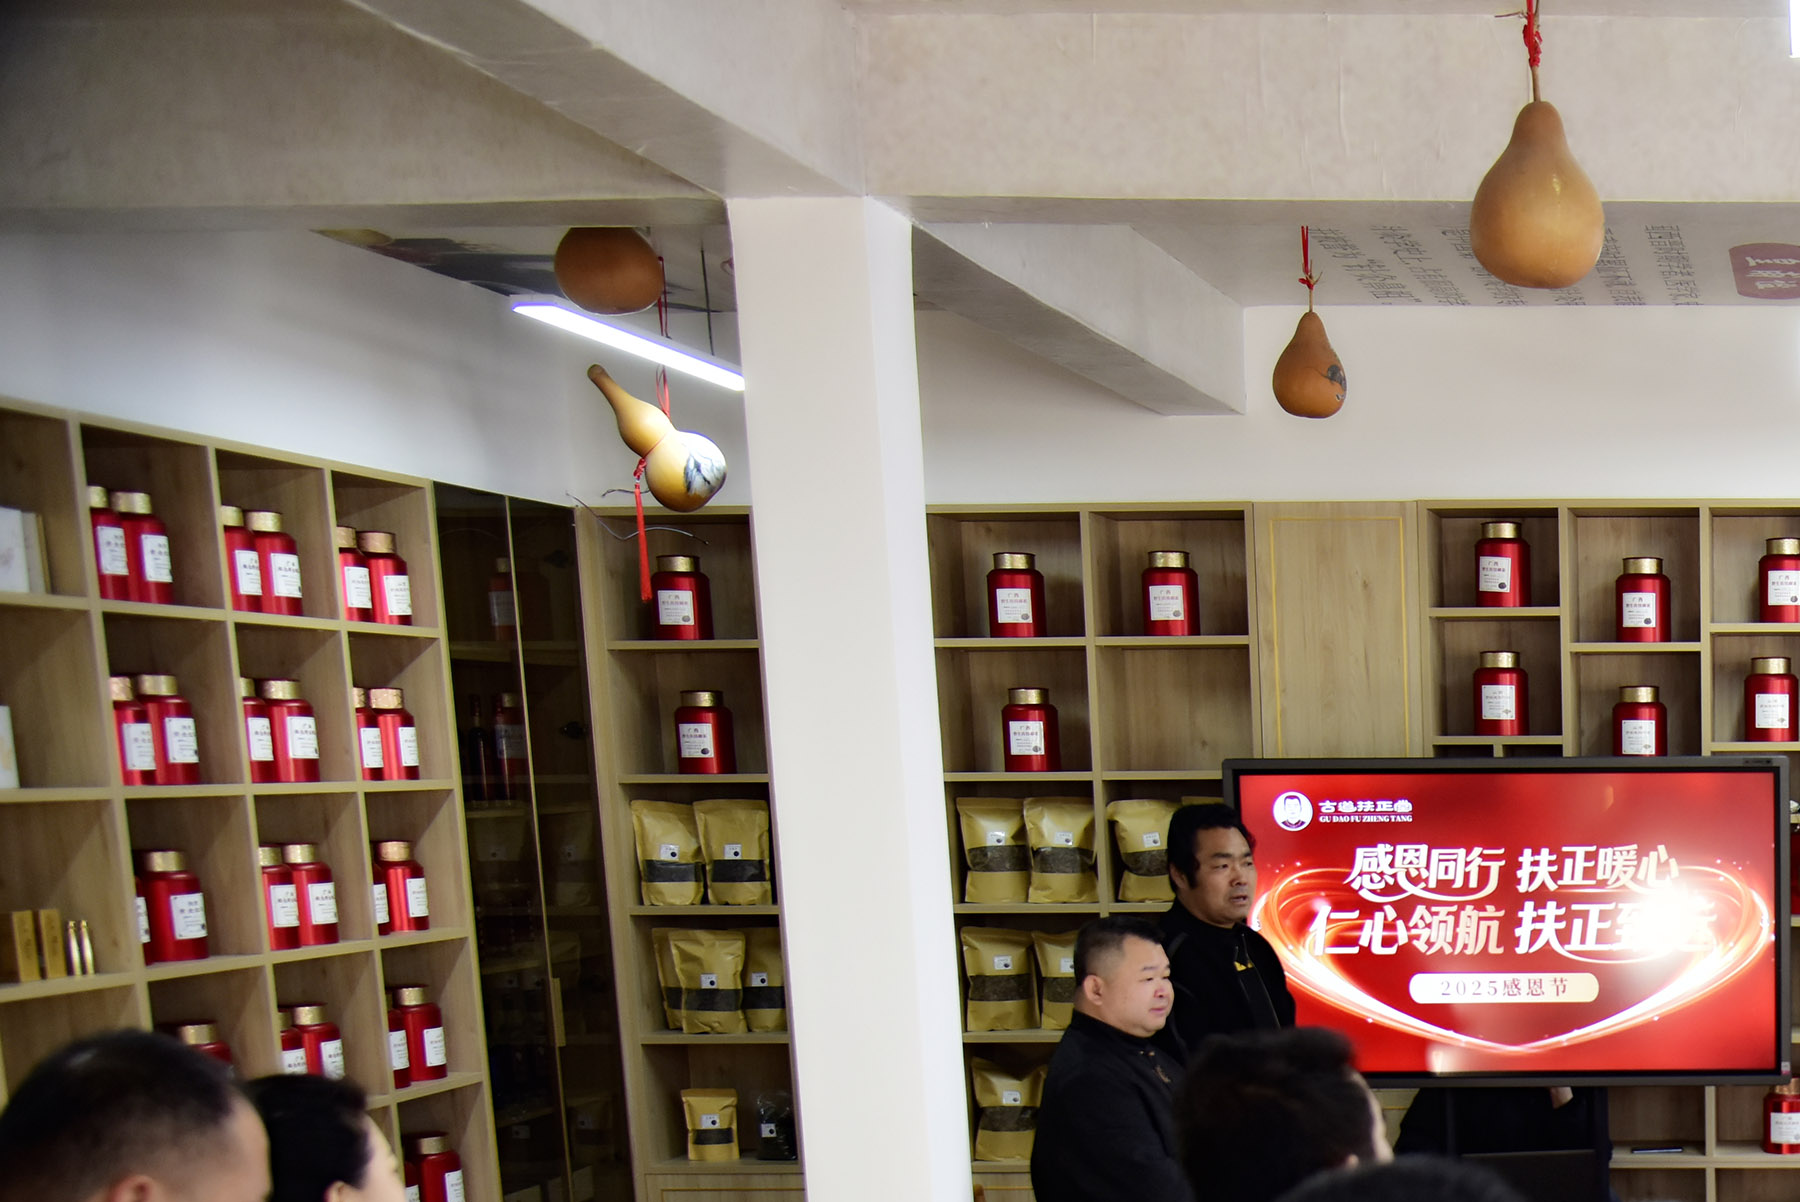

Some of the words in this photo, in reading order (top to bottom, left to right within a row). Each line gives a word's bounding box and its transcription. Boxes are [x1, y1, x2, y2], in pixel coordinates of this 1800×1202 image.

[1318, 799, 1413, 813] 古道扶正堂
[1319, 815, 1331, 823] GU
[1332, 815, 1350, 823] DAO
[1350, 815, 1361, 823] FU
[1362, 815, 1389, 823] ZHENG
[1391, 815, 1413, 823] TANG
[1343, 844, 1506, 902] 感恩同行
[1516, 844, 1681, 893] 扶正暖心
[1307, 904, 1506, 956] 仁心领航
[1440, 977, 1569, 998] 2025感恩节
